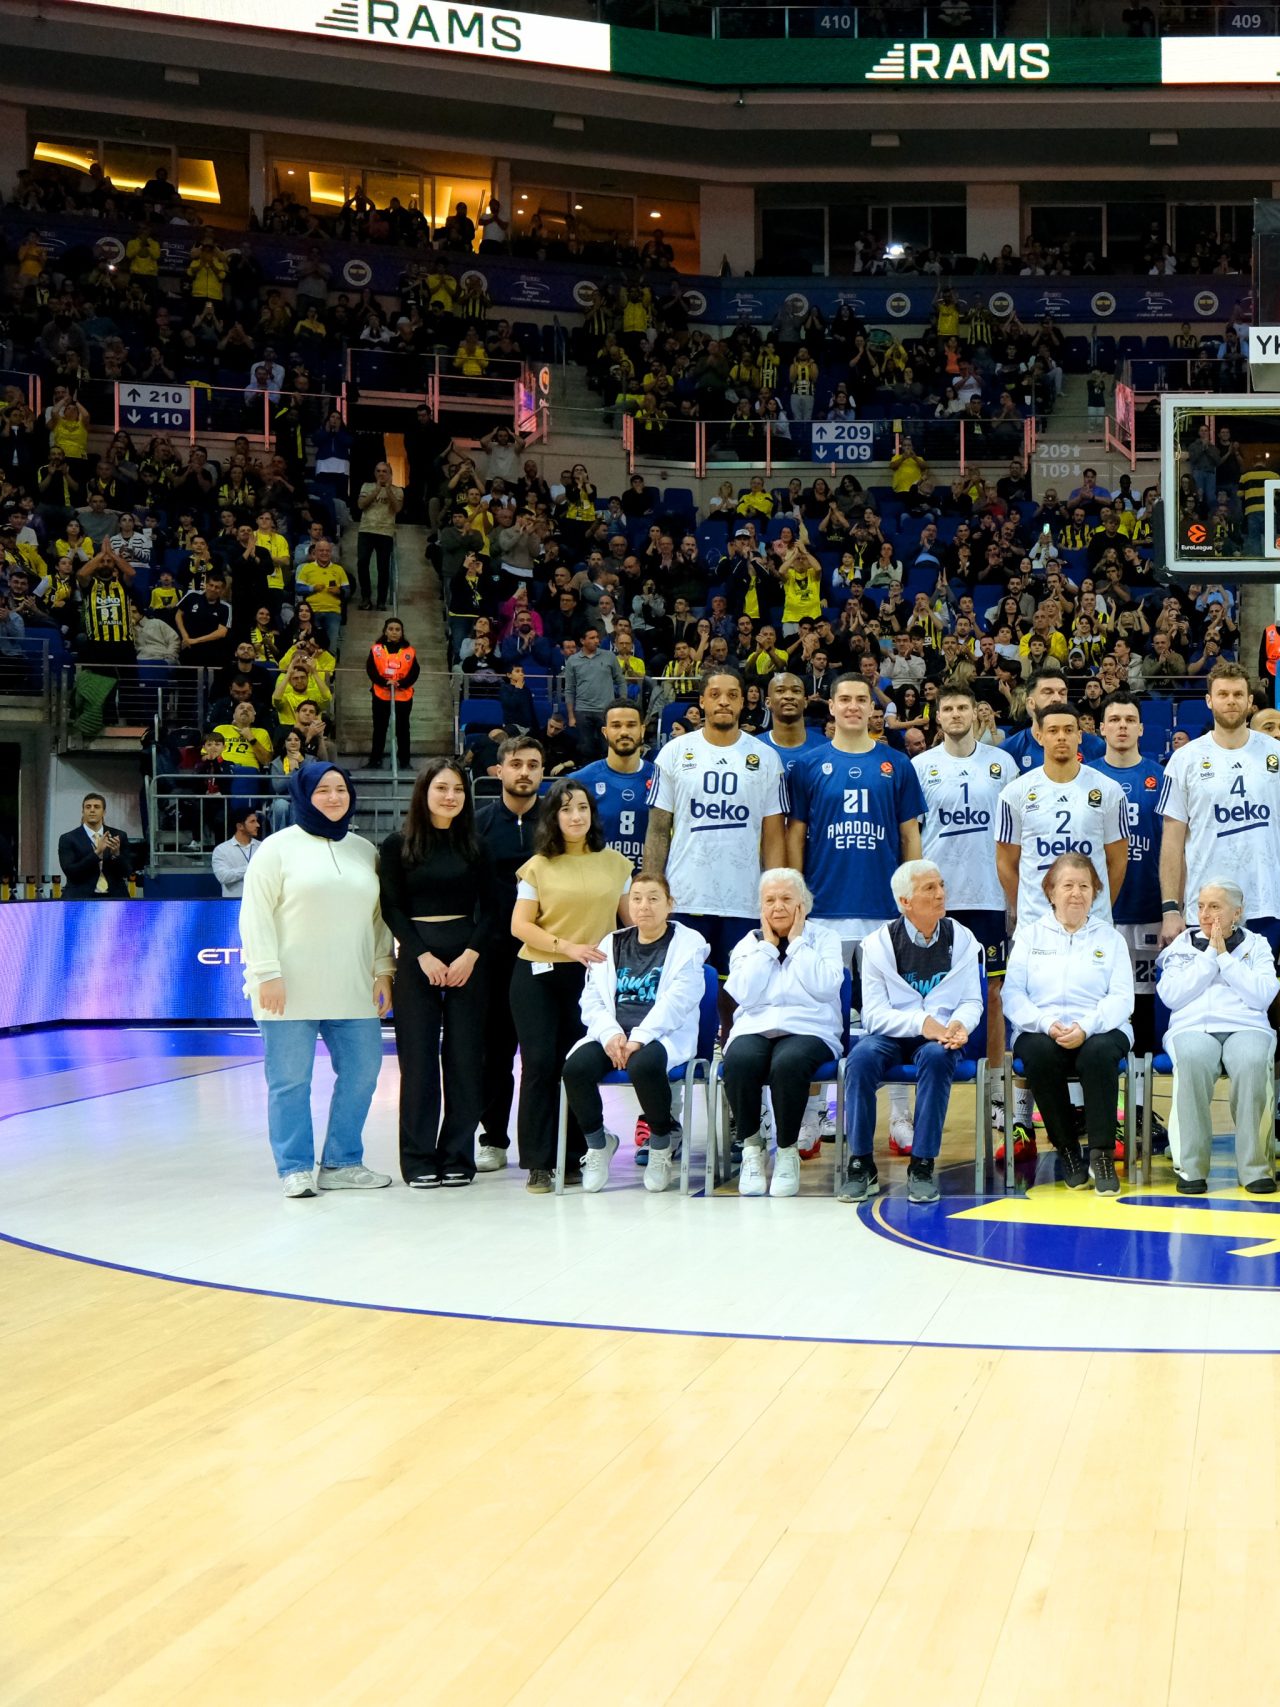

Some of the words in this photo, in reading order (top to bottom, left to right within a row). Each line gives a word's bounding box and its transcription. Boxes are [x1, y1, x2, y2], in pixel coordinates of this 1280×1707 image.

[366, 0, 522, 52] RAMS
[821, 15, 850, 29] 410
[1231, 14, 1261, 29] 409
[909, 43, 1050, 80] RAMS
[149, 391, 183, 404] 210
[149, 412, 183, 425] 110
[834, 425, 871, 441] 209
[834, 445, 871, 460] 109
[1039, 444, 1071, 459] 209
[1040, 464, 1071, 478] 109
[96, 596, 120, 605] beko
[703, 771, 738, 795] 00
[1230, 775, 1247, 799] 4
[843, 789, 869, 814] 21
[959, 782, 969, 804] 1
[691, 798, 750, 822] beko
[938, 807, 990, 826] beko
[1214, 800, 1270, 824] beko
[619, 811, 635, 835] 8
[827, 821, 886, 841] ANADOLU
[1055, 811, 1071, 833] 2
[606, 841, 644, 855] NADOL
[835, 836, 876, 850] EFES
[1037, 837, 1092, 857] beko
